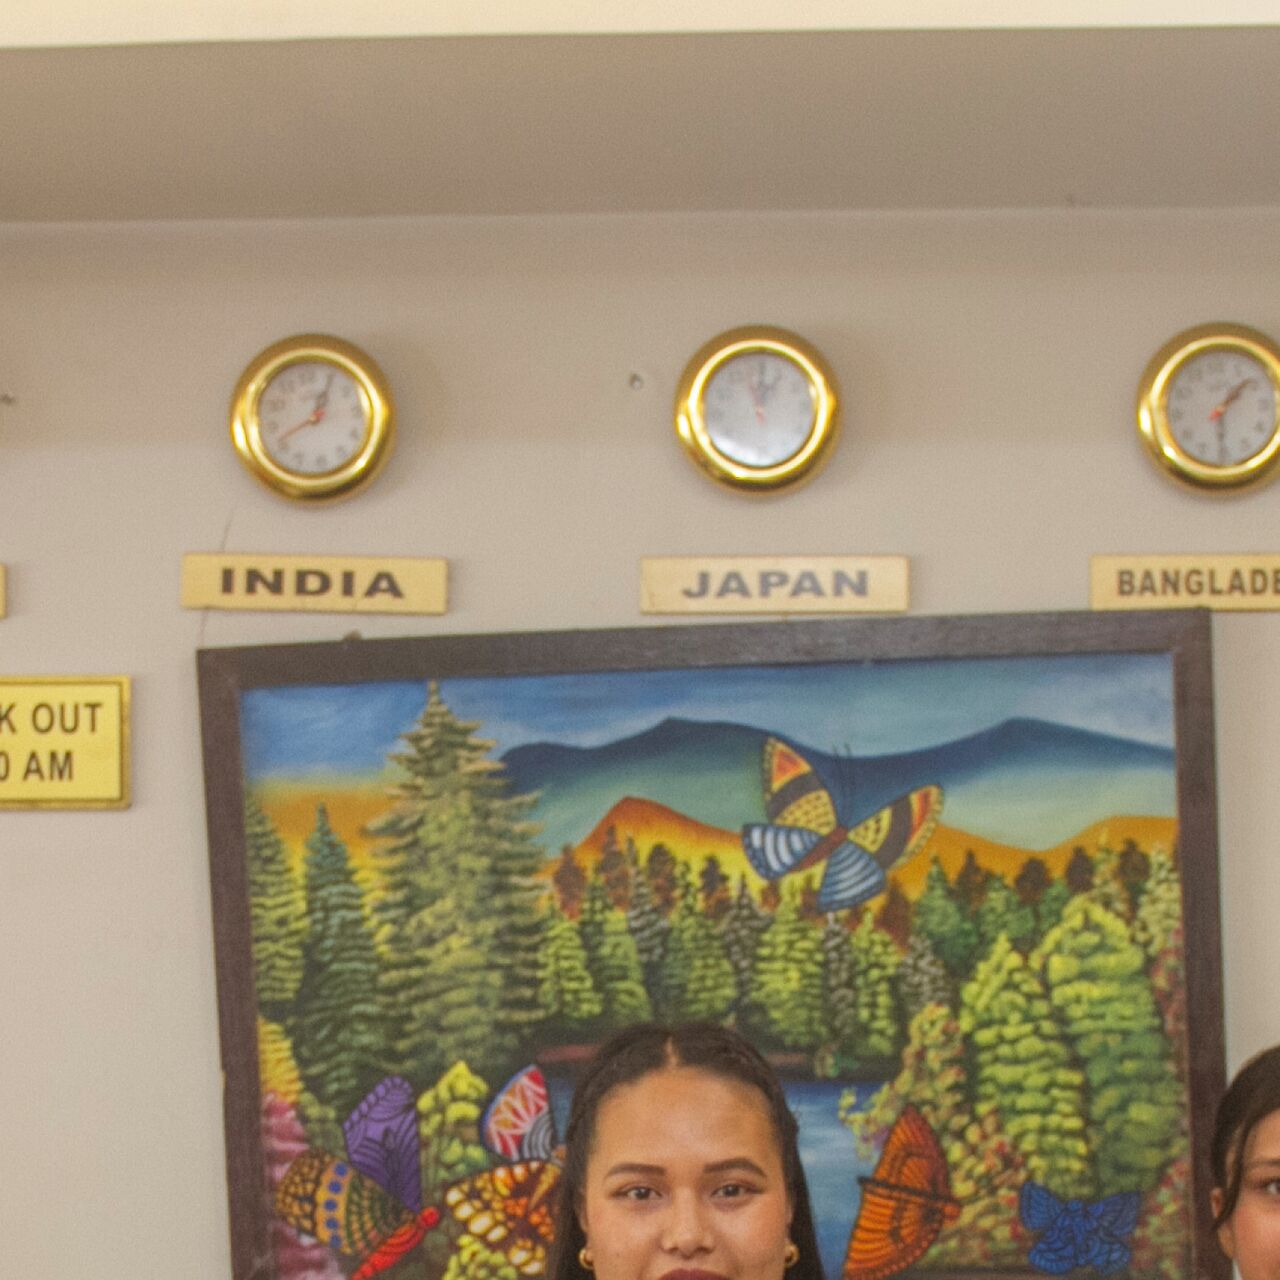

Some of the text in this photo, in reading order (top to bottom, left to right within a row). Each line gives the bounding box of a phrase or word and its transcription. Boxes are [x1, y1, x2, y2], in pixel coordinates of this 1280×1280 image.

[220, 566, 405, 599] INDIA
[681, 569, 870, 599] JAPAN
[31, 702, 102, 735] OUT
[22, 750, 74, 783] AM
